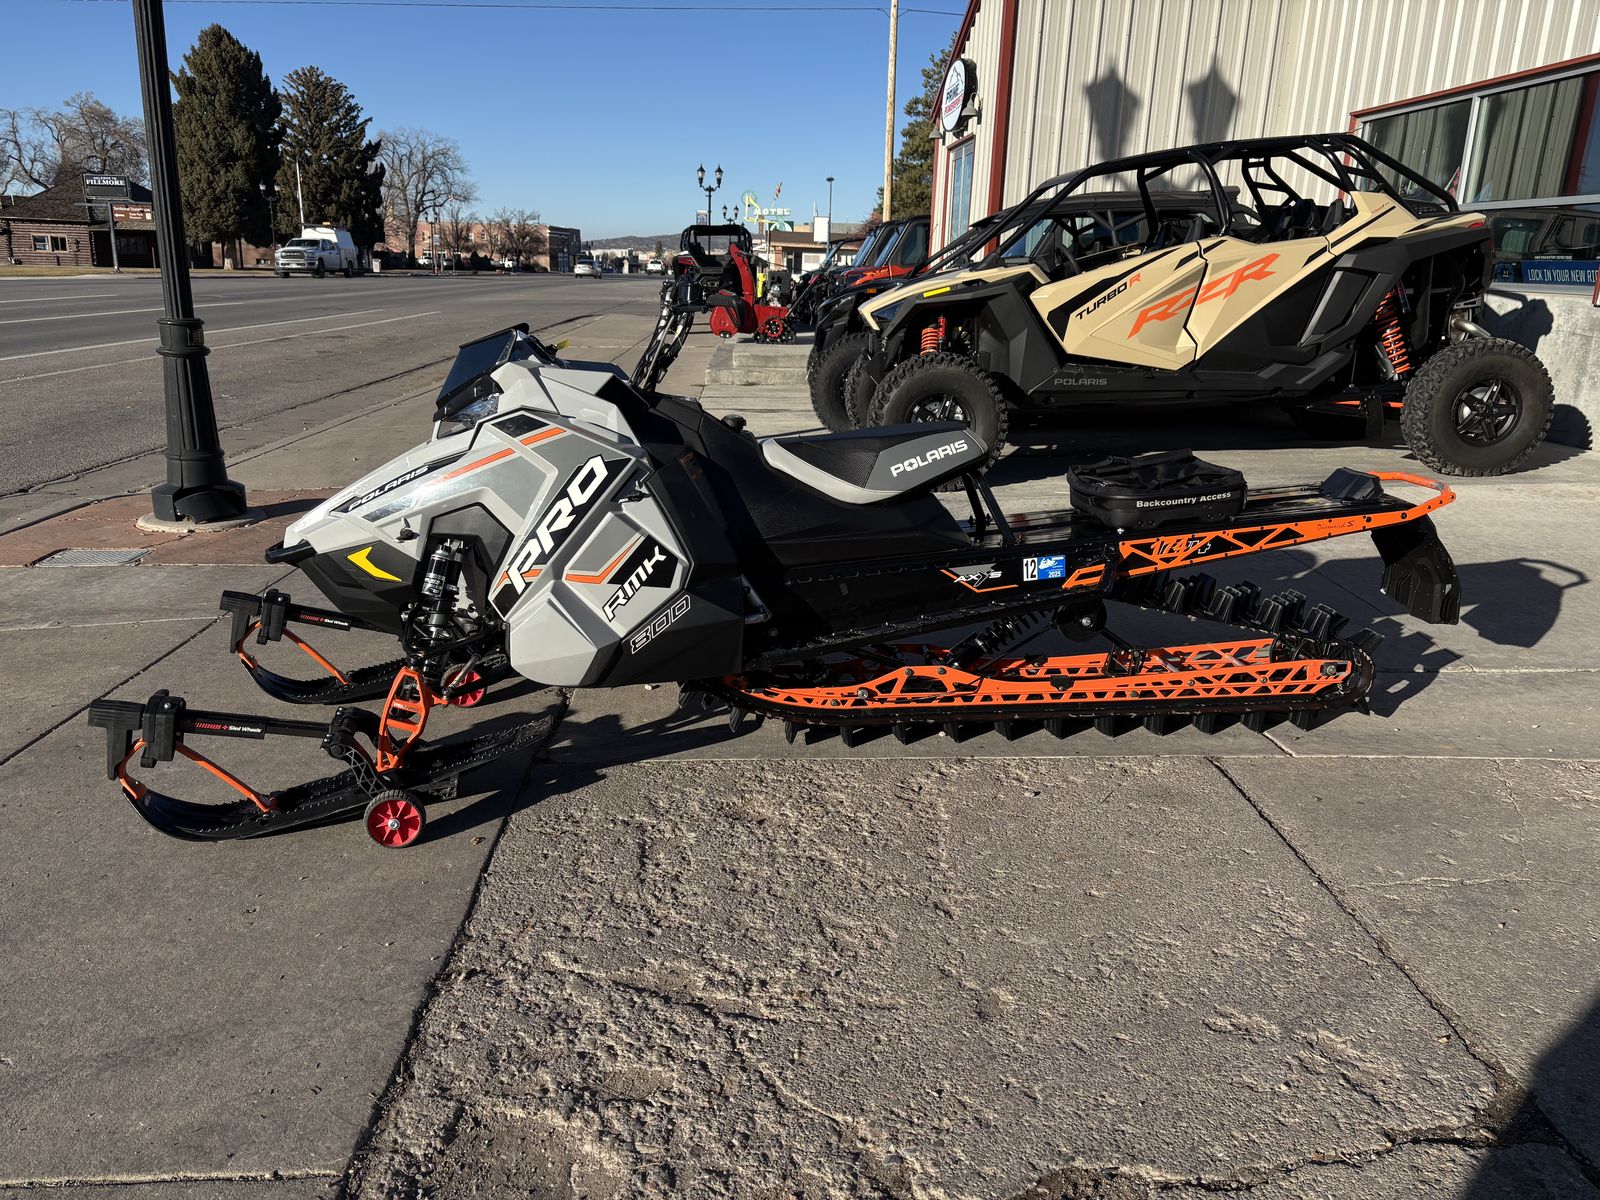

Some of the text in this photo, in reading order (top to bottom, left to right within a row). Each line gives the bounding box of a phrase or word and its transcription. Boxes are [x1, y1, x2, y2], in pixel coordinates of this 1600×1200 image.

[1528, 268, 1543, 281] LOCK
[1543, 269, 1552, 282] IN
[1552, 269, 1570, 282] YOUR
[1570, 269, 1586, 283] NEW
[1127, 252, 1281, 340] RZR
[1054, 378, 1108, 386] POLARIS
[890, 439, 968, 478] POLARIS
[347, 464, 429, 512] POLARIS
[1136, 491, 1232, 508] Backcountry Access
[506, 454, 609, 596] PRO
[602, 545, 667, 623] RMK
[953, 568, 1003, 588] AXYS
[1024, 559, 1037, 580] 12
[1048, 570, 1062, 578] 2025
[630, 594, 691, 655] 800
